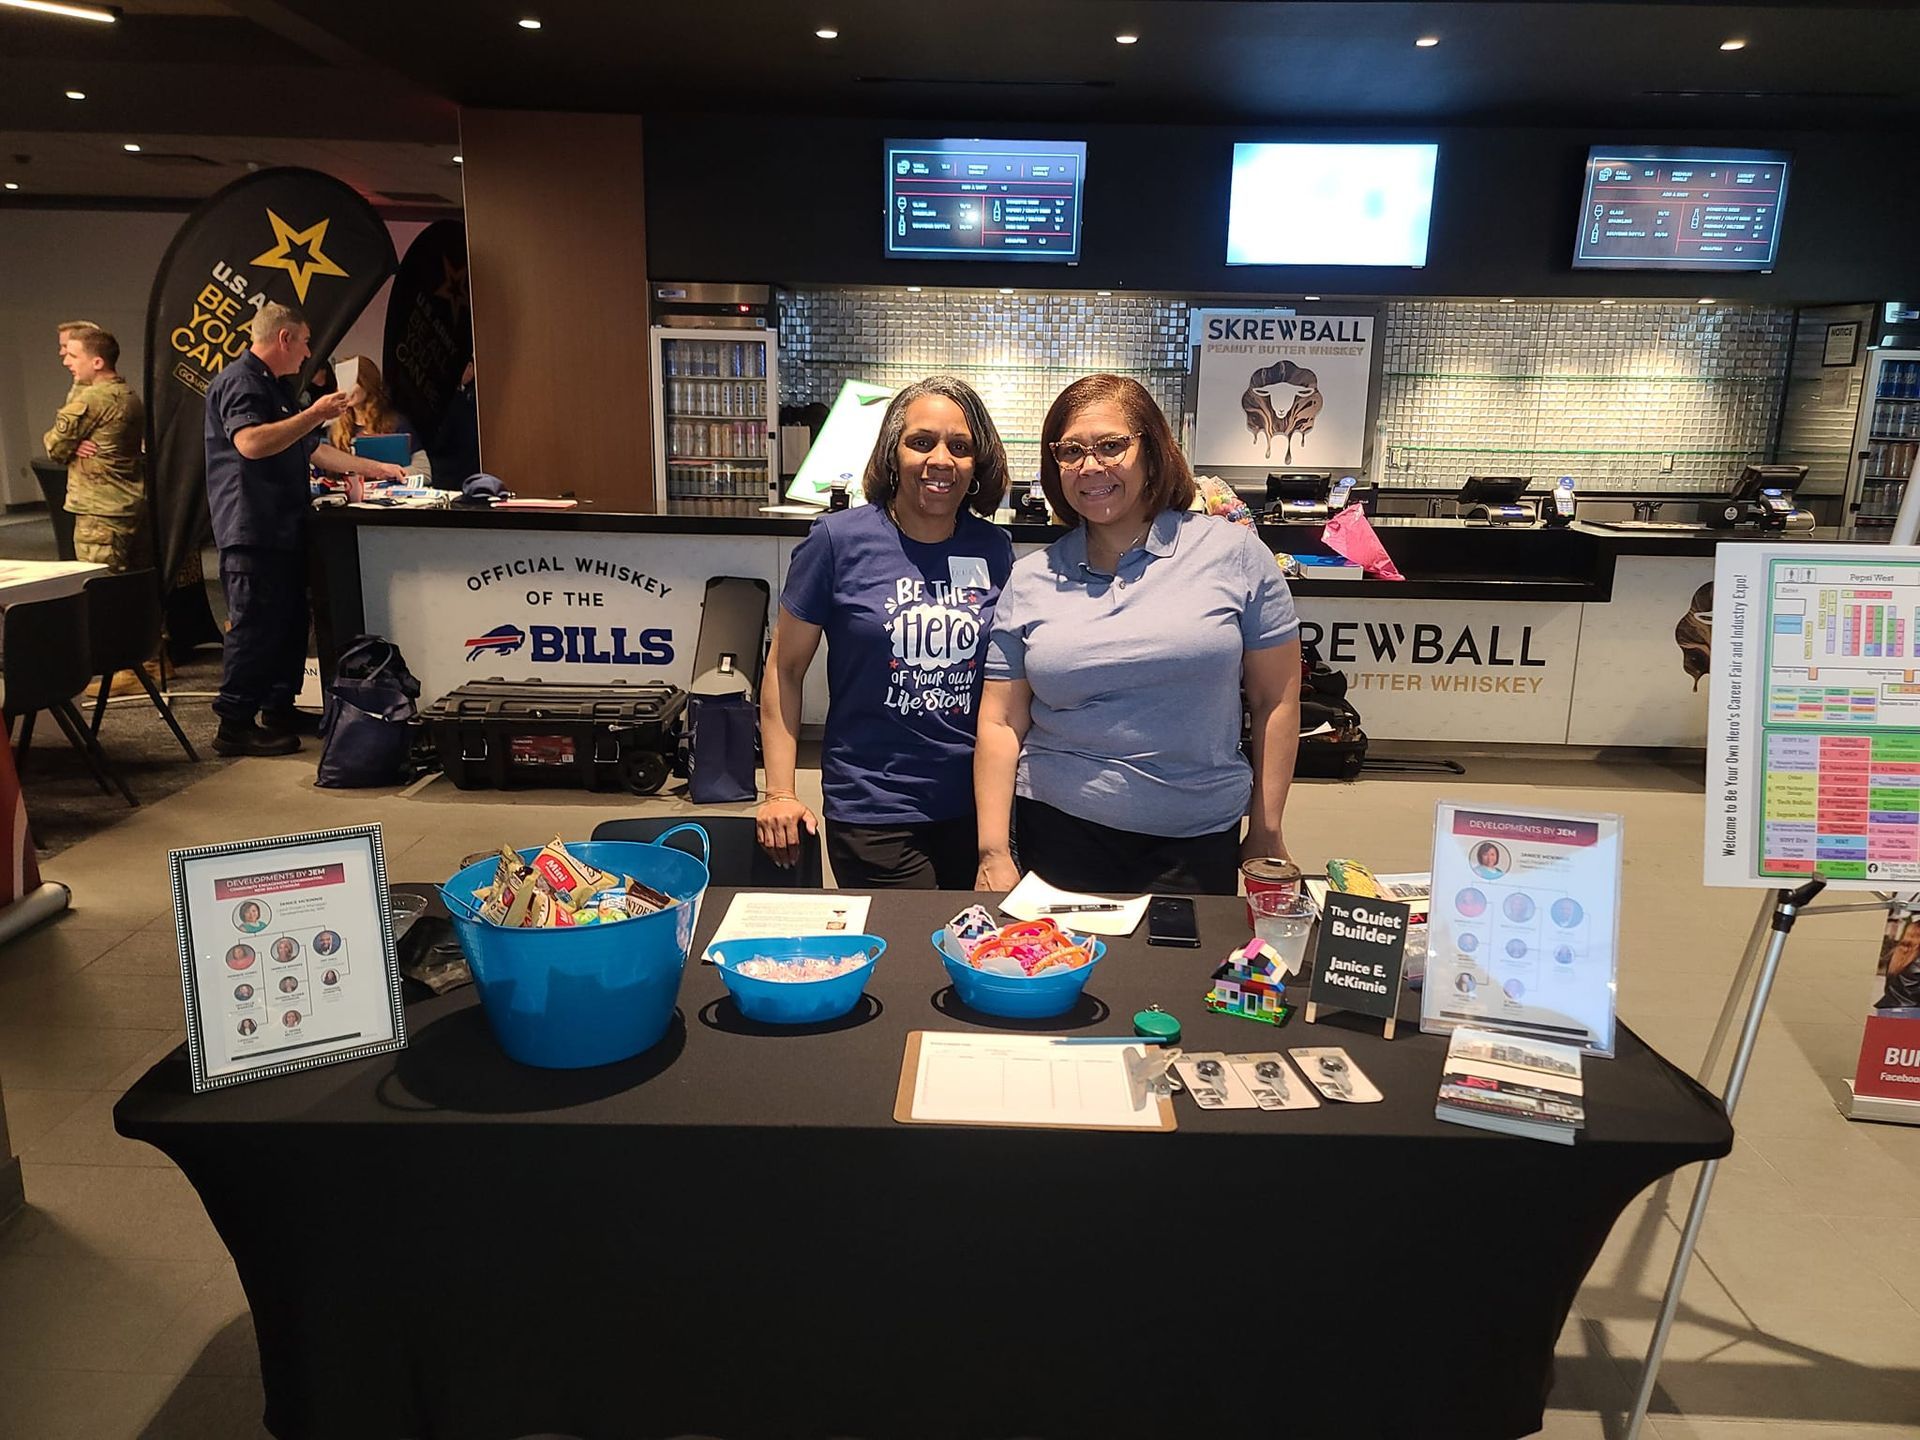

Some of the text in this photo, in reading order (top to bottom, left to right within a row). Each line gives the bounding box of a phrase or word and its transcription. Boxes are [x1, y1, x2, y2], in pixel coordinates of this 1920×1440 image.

[212, 260, 248, 299] U.S.
[197, 283, 242, 325] BE
[188, 303, 248, 358] YOU
[1208, 318, 1366, 342] SKREWBALL
[1831, 327, 1853, 337] NOTICE
[1207, 344, 1365, 357] PEANUT BUTTER WHISKEY
[467, 556, 672, 598] OFFICIAL WHISKEY
[1849, 573, 1895, 582] Pepsi West
[526, 590, 604, 607] OF THE
[896, 577, 968, 607] BE THE
[529, 625, 675, 665] BILLS
[1300, 621, 1546, 667] REWBALL
[891, 670, 909, 687] OF
[1346, 673, 1544, 694] UTTER WHISKEY
[883, 686, 973, 716] Life Story
[1723, 574, 1750, 857] Welcome to Be Your Own Hero's Career Fair and Industry Expo!
[1469, 818, 1577, 838] DEVELOPMENTS BY JEM
[226, 868, 326, 888] DEVELOPMENTS BY JEM
[546, 859, 568, 882] Mini
[1330, 905, 1402, 929] The Quiet
[1332, 921, 1397, 945] Builder
[1329, 956, 1387, 978] Janice E.
[1324, 970, 1388, 995] McKinnie
[1880, 1072, 1920, 1084] Faceboo
